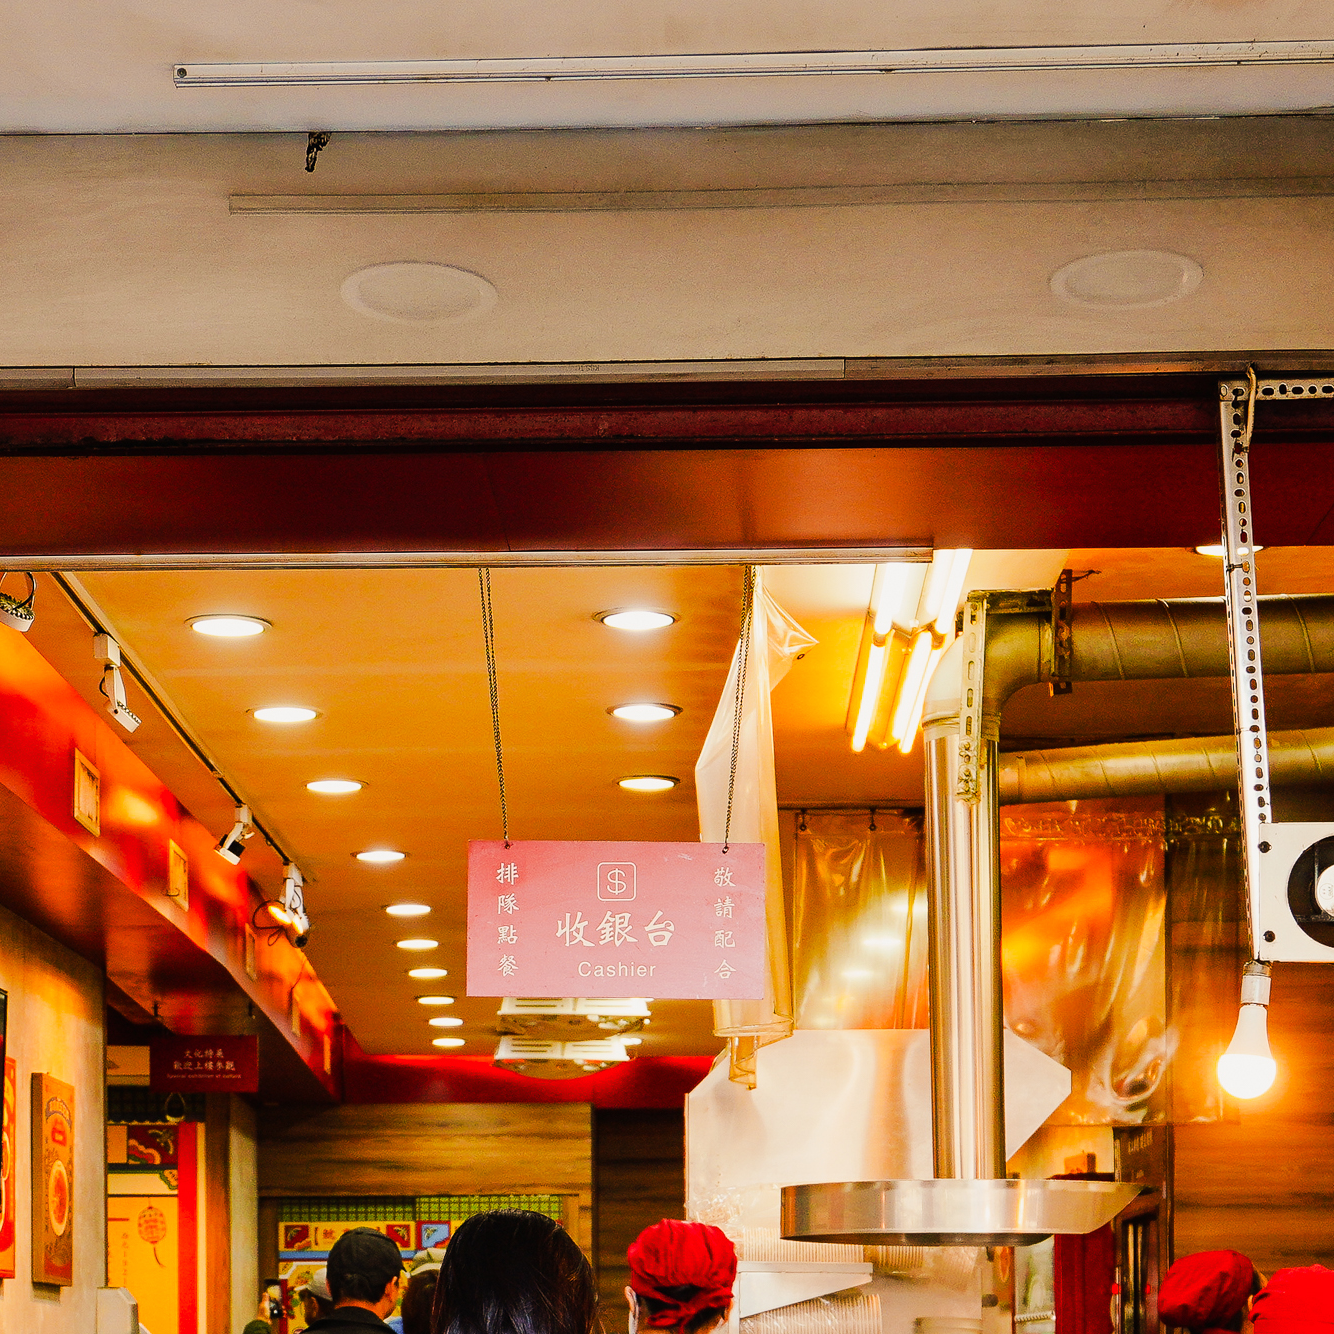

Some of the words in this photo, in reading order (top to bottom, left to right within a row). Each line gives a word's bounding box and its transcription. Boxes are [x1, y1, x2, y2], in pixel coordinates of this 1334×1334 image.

[496, 862, 520, 978] 排隊點餐
[555, 910, 675, 948] 收銀台
[713, 866, 736, 980] 敬請配合
[578, 960, 656, 978] Cashier
